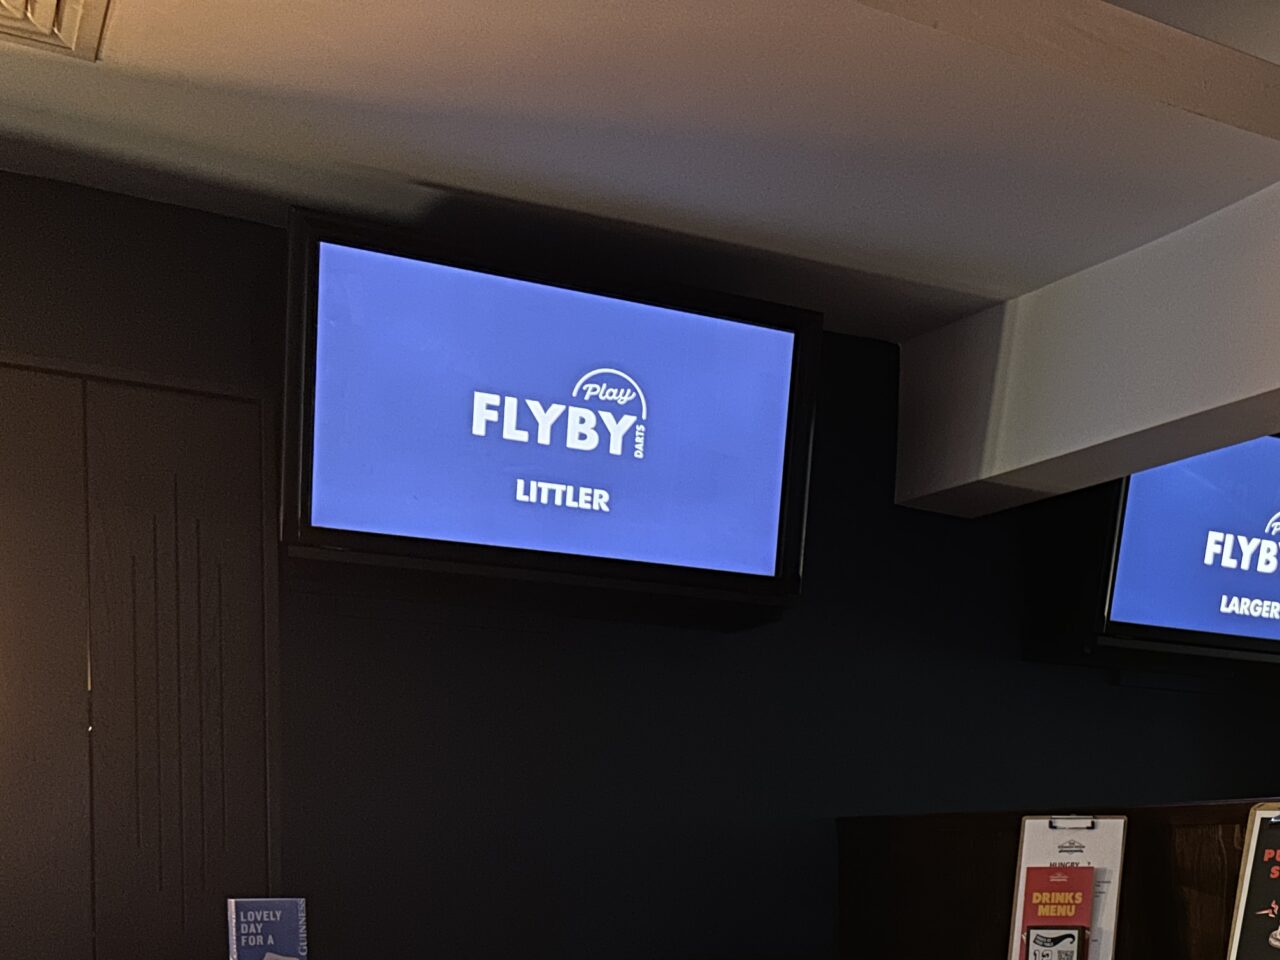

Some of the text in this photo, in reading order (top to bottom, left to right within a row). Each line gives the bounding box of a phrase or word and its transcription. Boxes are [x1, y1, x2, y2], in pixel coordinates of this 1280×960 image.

[582, 383, 637, 405] Play
[471, 390, 638, 456] FLYBY
[633, 424, 646, 459] DARTS
[515, 478, 610, 512] LITTLER
[1220, 594, 1280, 620] LARGER
[1032, 892, 1083, 904] DRINKS
[240, 910, 282, 922] LOVELY
[1037, 904, 1076, 917] MENU
[241, 923, 263, 934] DAY
[241, 934, 274, 946] FOR A
